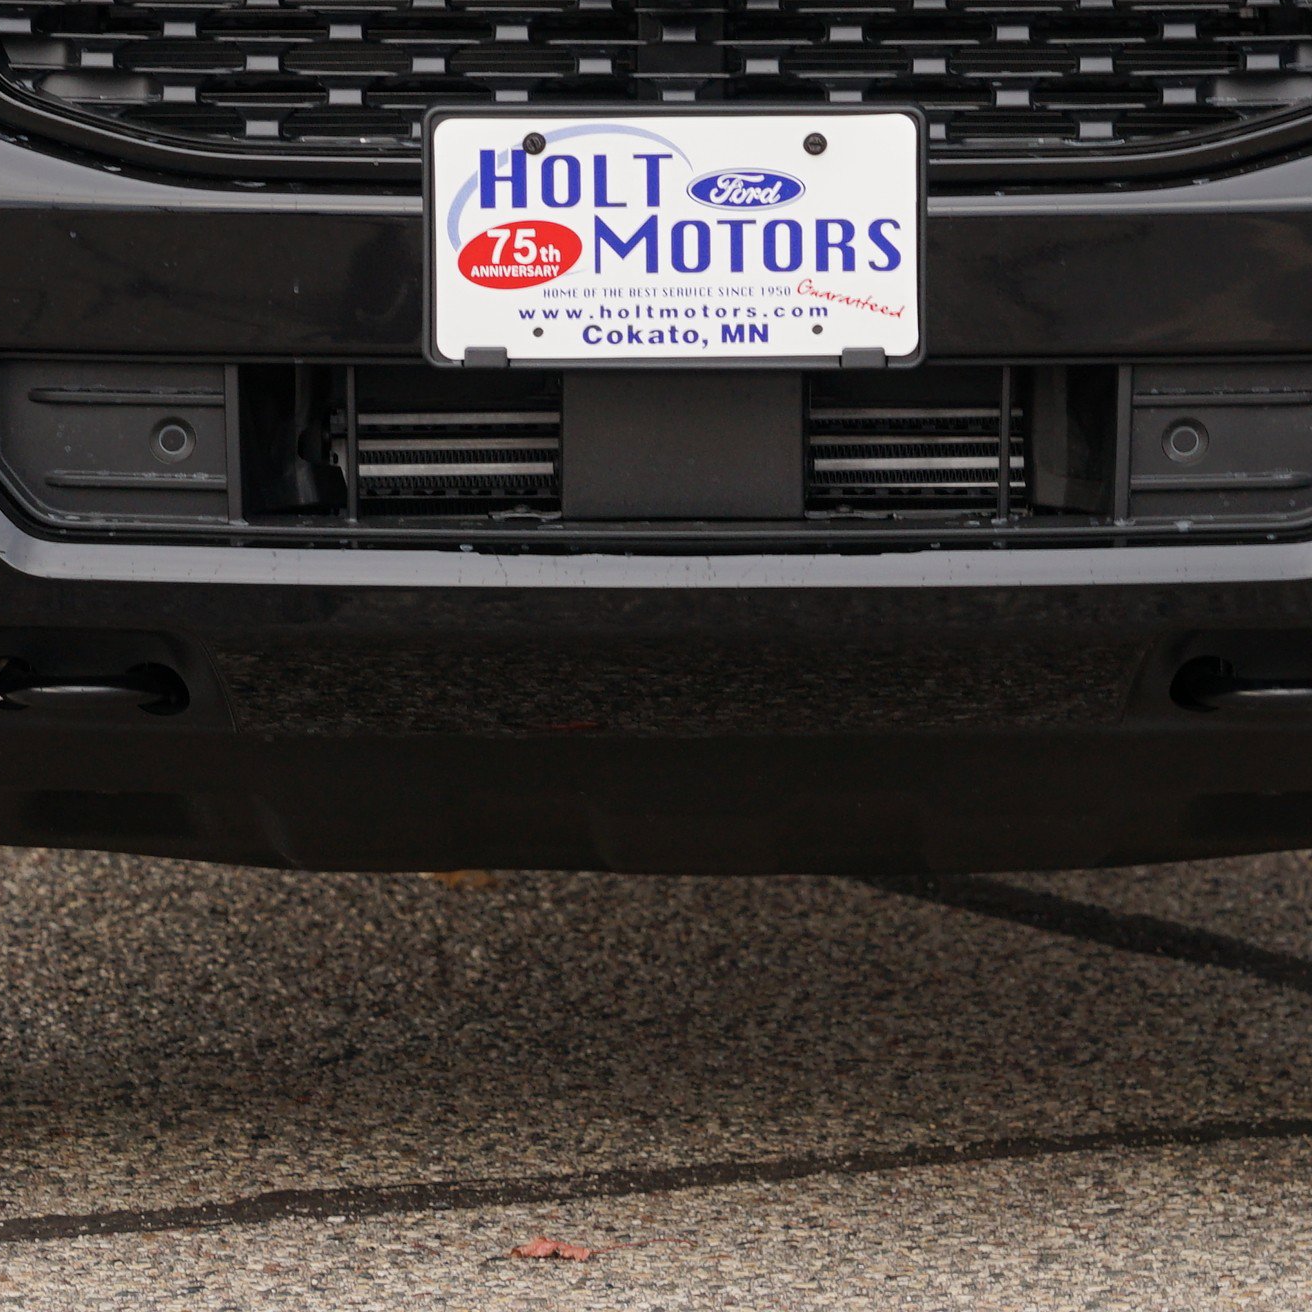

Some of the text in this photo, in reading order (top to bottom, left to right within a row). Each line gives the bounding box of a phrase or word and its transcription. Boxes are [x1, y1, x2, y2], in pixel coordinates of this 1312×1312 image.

[479, 149, 673, 208] HOLT
[709, 173, 782, 206] Ford
[486, 228, 561, 265] 75th
[593, 214, 901, 274] MOTORS
[470, 265, 560, 278] ANNIVERSARY
[543, 286, 791, 298] HOME OF THE BEST SERVICE SINCE 1950
[797, 278, 905, 319] Guaranteed
[518, 302, 829, 320] www.holtmotors.com
[582, 323, 770, 349] Cokato, MN
